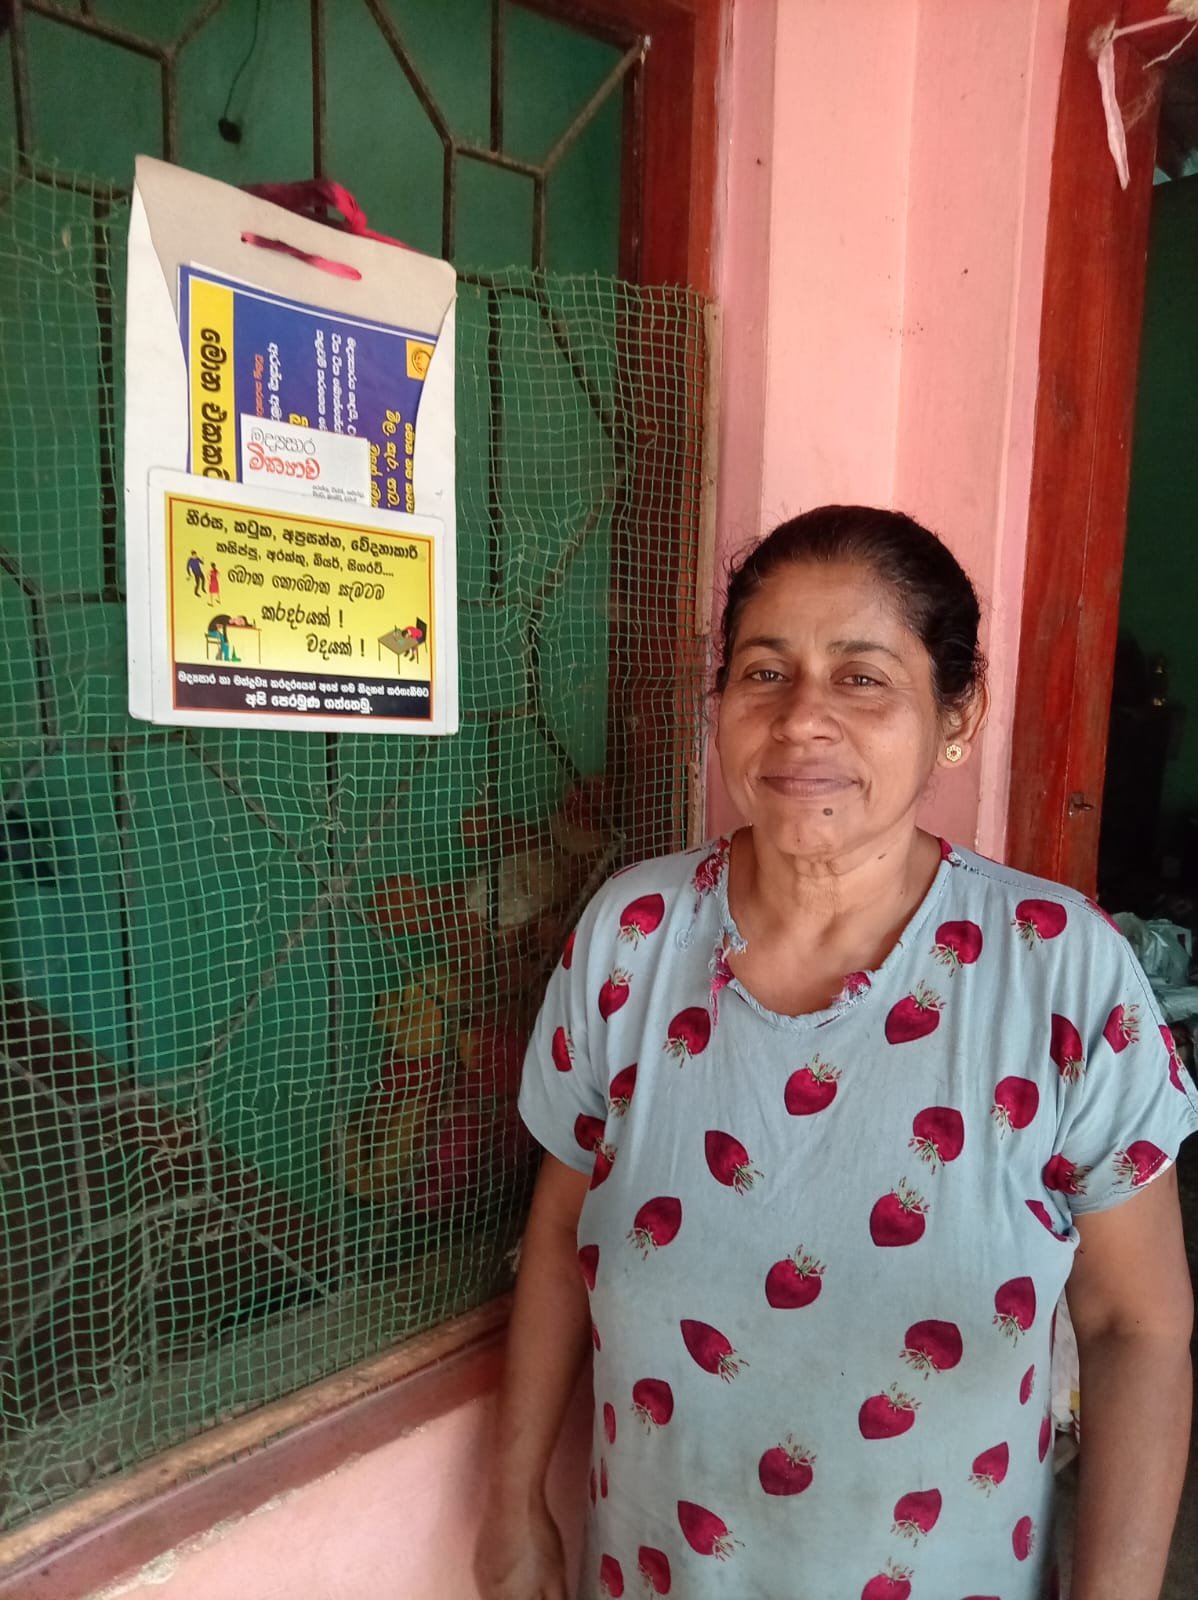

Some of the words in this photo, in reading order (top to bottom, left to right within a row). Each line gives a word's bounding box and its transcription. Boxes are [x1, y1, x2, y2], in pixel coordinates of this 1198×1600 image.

[186, 508, 228, 533] නීරස,
[234, 520, 276, 541] කටුක,
[266, 549, 309, 567] අරක්කු,
[261, 601, 331, 630] කරදරයක්
[338, 609, 344, 629] !
[305, 633, 352, 660] වදයක්
[360, 638, 365, 657] !
[245, 691, 267, 708] අපි
[271, 693, 320, 712] පෙරමුණ
